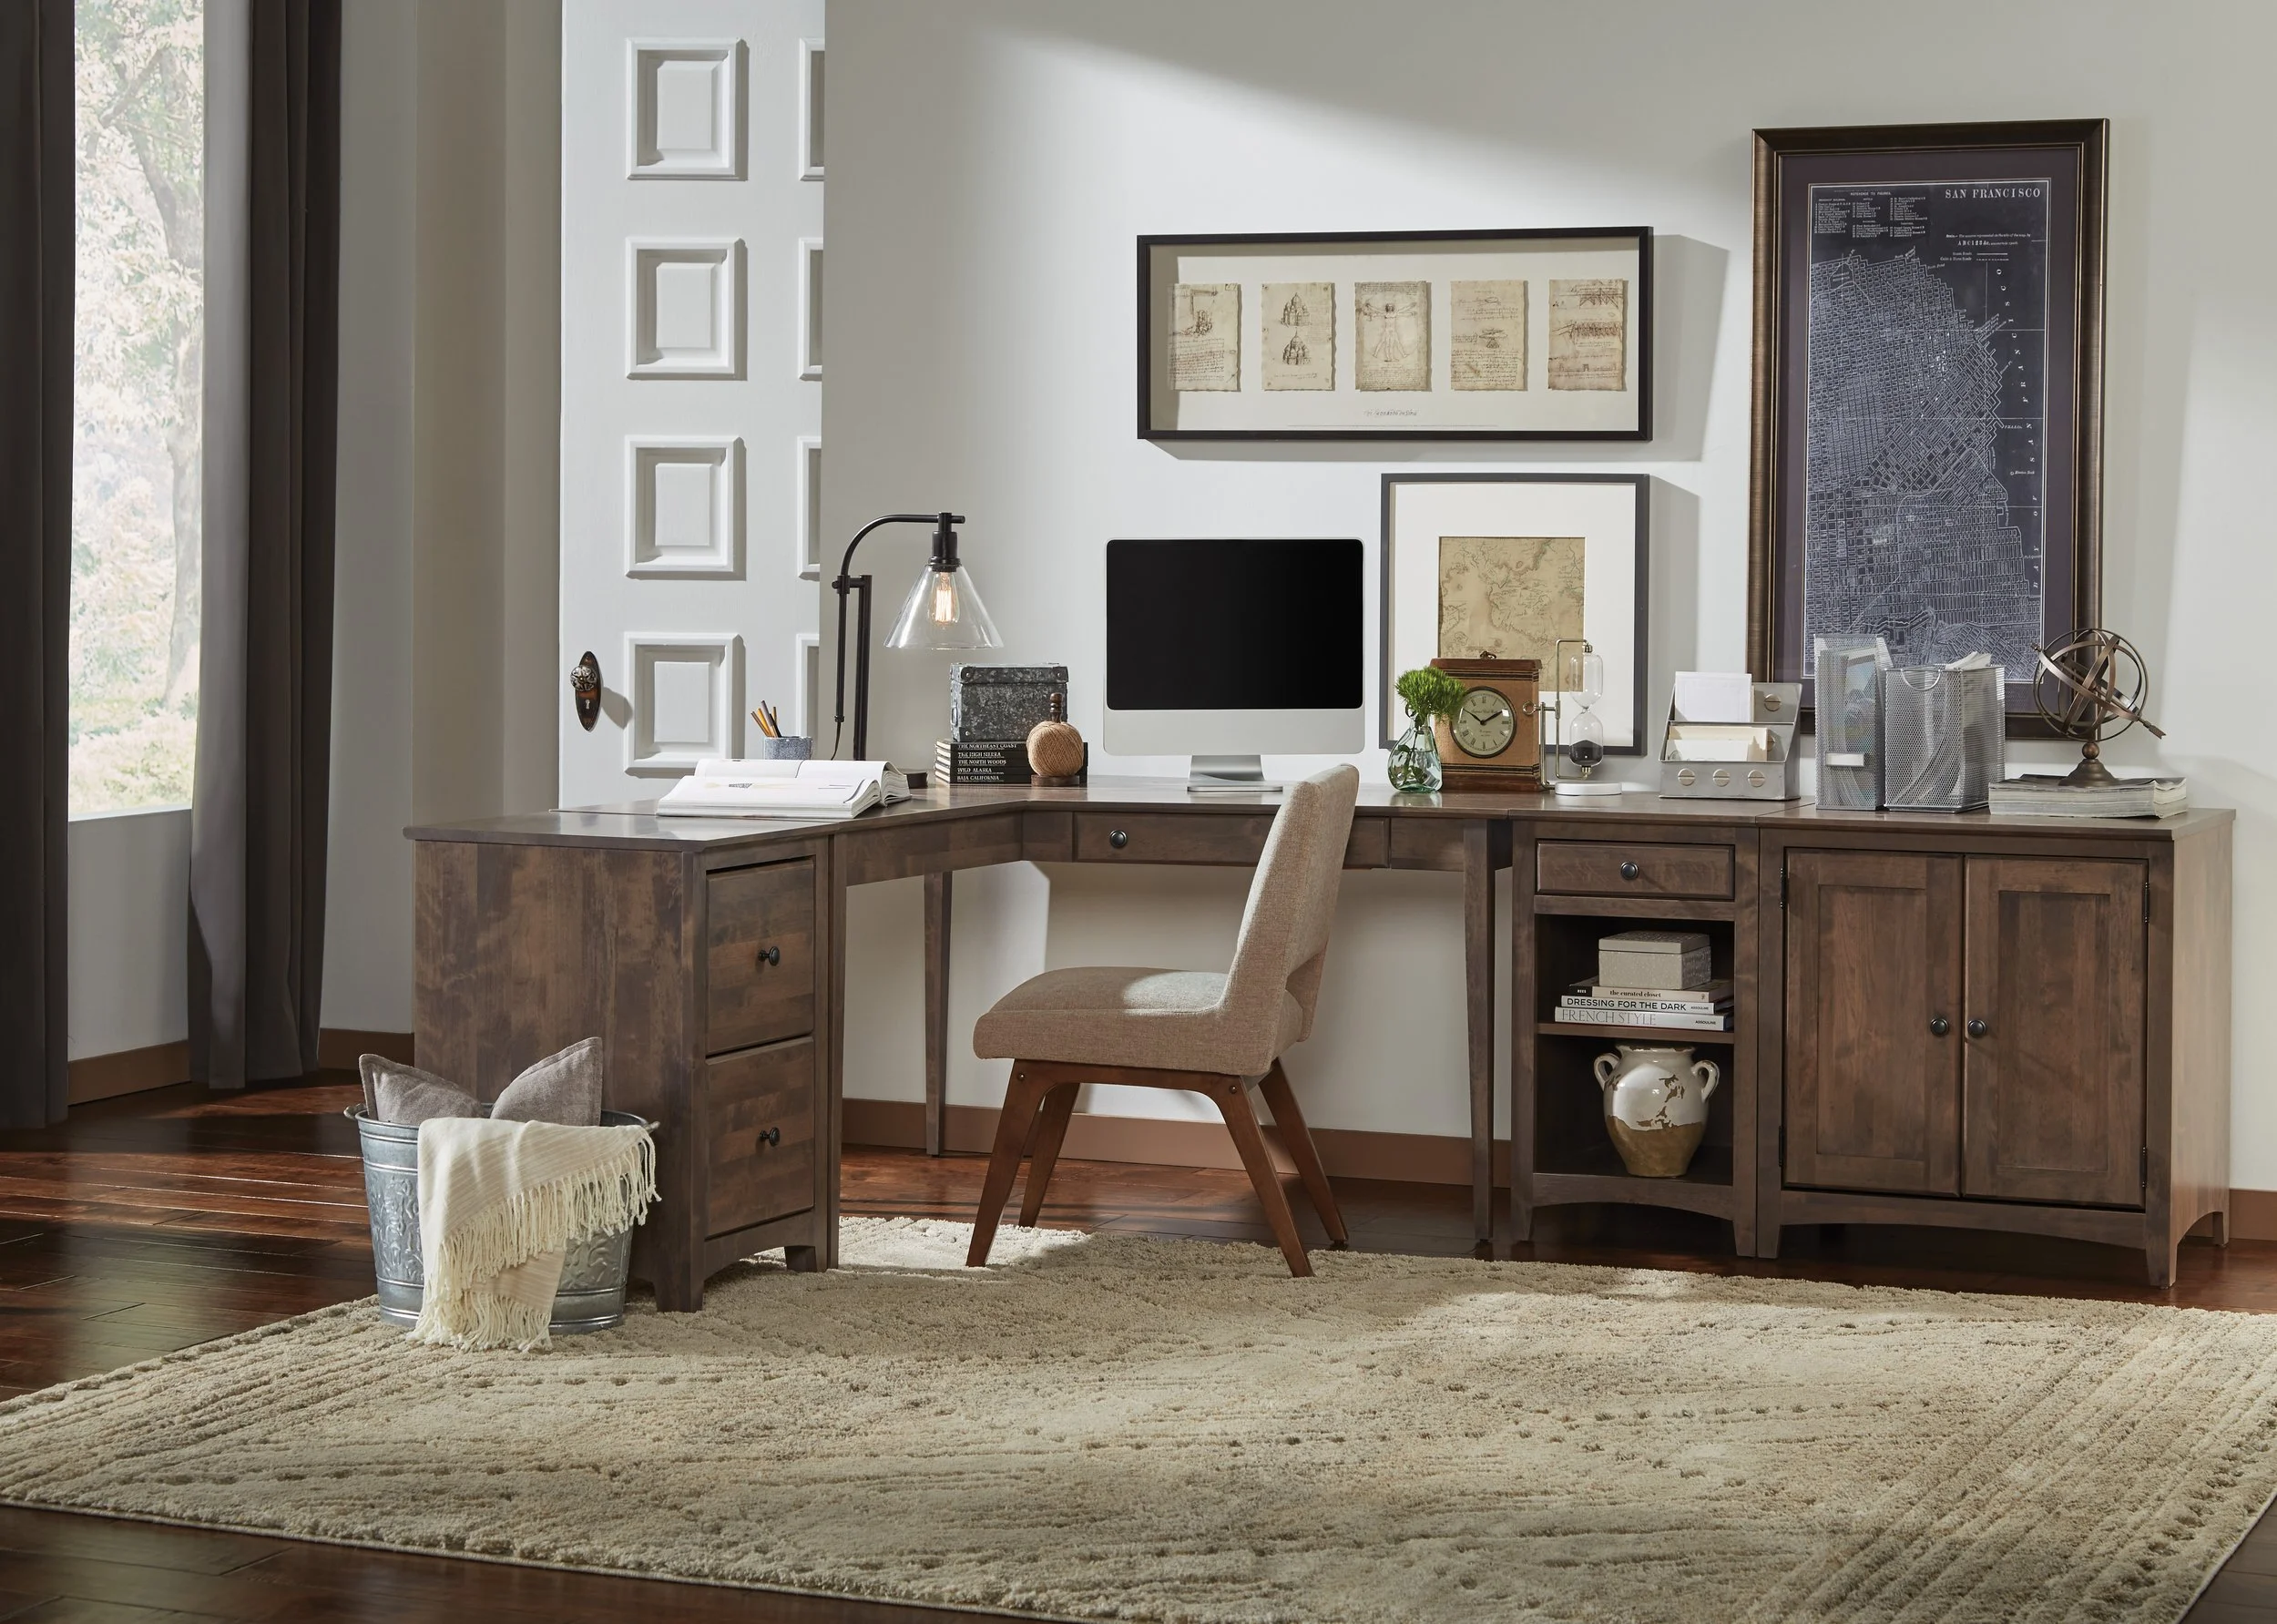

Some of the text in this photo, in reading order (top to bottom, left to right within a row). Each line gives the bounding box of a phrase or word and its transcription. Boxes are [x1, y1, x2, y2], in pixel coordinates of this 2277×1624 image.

[1945, 188, 2040, 199] SAN FRANCISCO
[1567, 997, 1687, 1011] DRESSING FOR THE DARK
[1562, 1008, 1657, 1026] FRENCH STYLE
